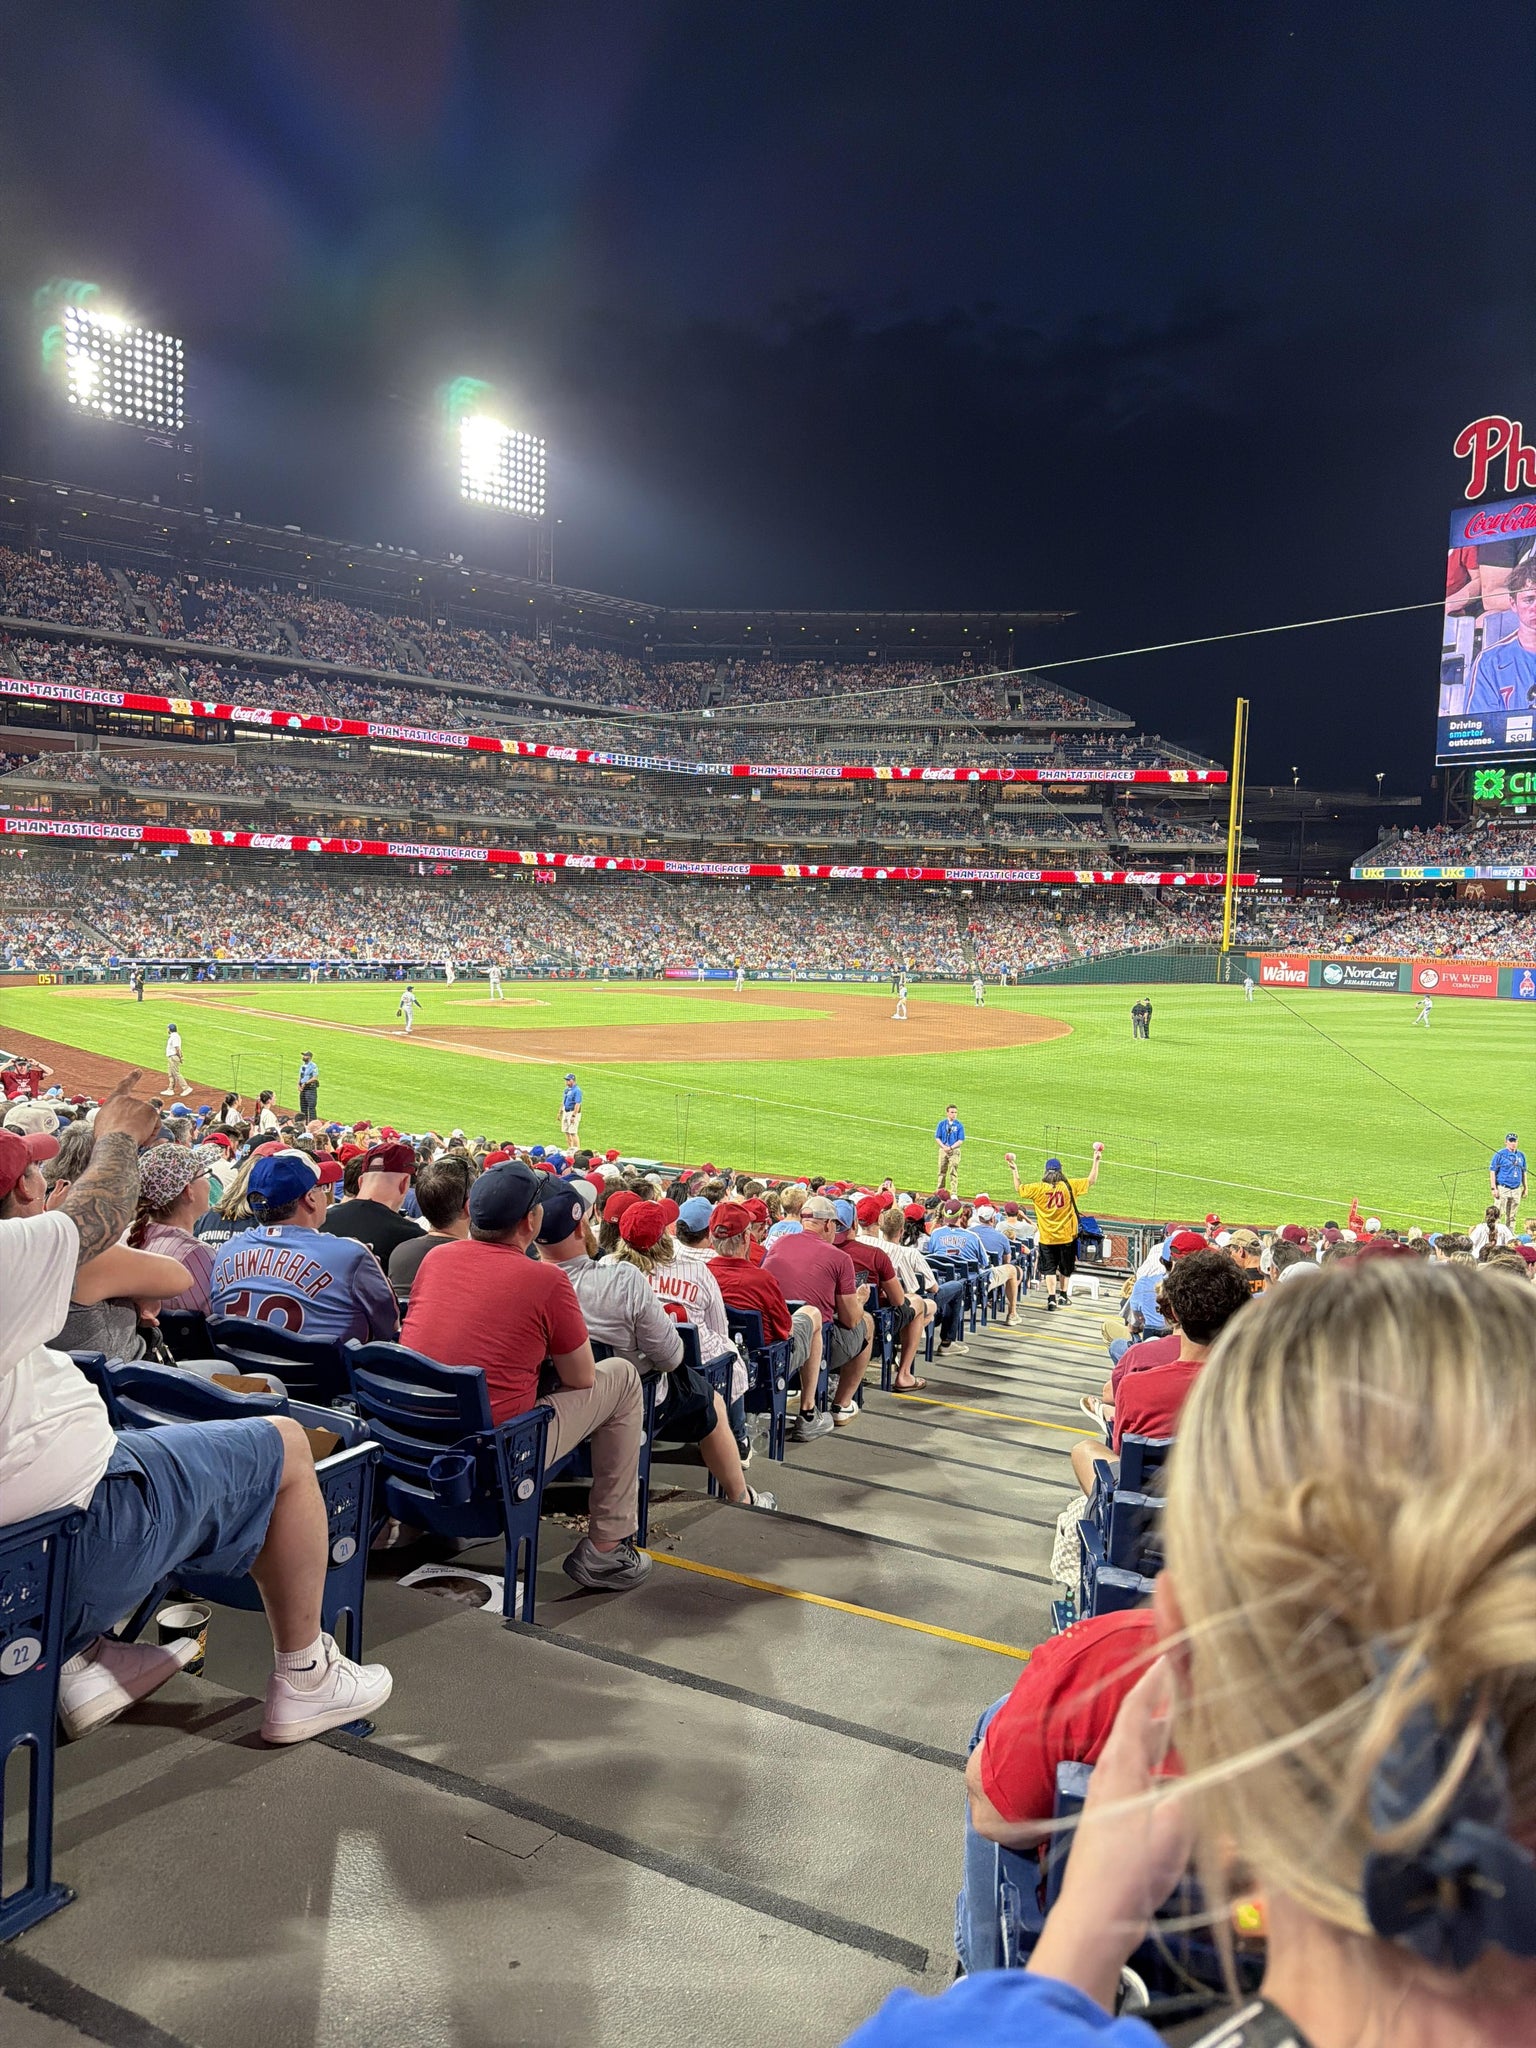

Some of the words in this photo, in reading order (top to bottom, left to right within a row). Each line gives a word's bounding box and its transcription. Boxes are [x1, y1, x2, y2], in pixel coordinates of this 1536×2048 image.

[84, 690, 124, 704] FACES
[1449, 721, 1482, 730] Driving
[369, 724, 438, 742] PHAN-TASTIC
[439, 734, 469, 746] FACES
[1449, 729, 1484, 739] smarter
[1448, 737, 1495, 747] outcomes.
[750, 766, 812, 776] PHAN-TASTIC
[814, 767, 842, 777] FACES
[1039, 770, 1103, 780] PHAN-TASTIC
[1105, 771, 1135, 781] FACES
[7, 820, 100, 836] PHAN-TASTIC
[102, 826, 143, 838] FACES
[389, 844, 457, 858] PHAN-TASTIC
[458, 848, 488, 860] FACES
[665, 861, 721, 873] PHAN-TASTIC
[722, 864, 750, 874] FACES
[1362, 868, 1385, 878] UKG
[1401, 868, 1424, 878] UKG
[1441, 868, 1465, 878] UKG
[946, 870, 1010, 880] PHAN-TASTIC
[1012, 871, 1042, 880] FACES
[1445, 959, 1488, 967] ASPLUNDH
[1496, 960, 1536, 968] ASPLUND
[1263, 966, 1307, 983] Wawa
[1343, 966, 1397, 980] NovaCare
[1462, 974, 1492, 983] WEBB
[1045, 1191, 1065, 1209] 70
[215, 1248, 335, 1300] SCHWARBER
[340, 1544, 349, 1556] 21
[13, 1646, 29, 1666] 22
